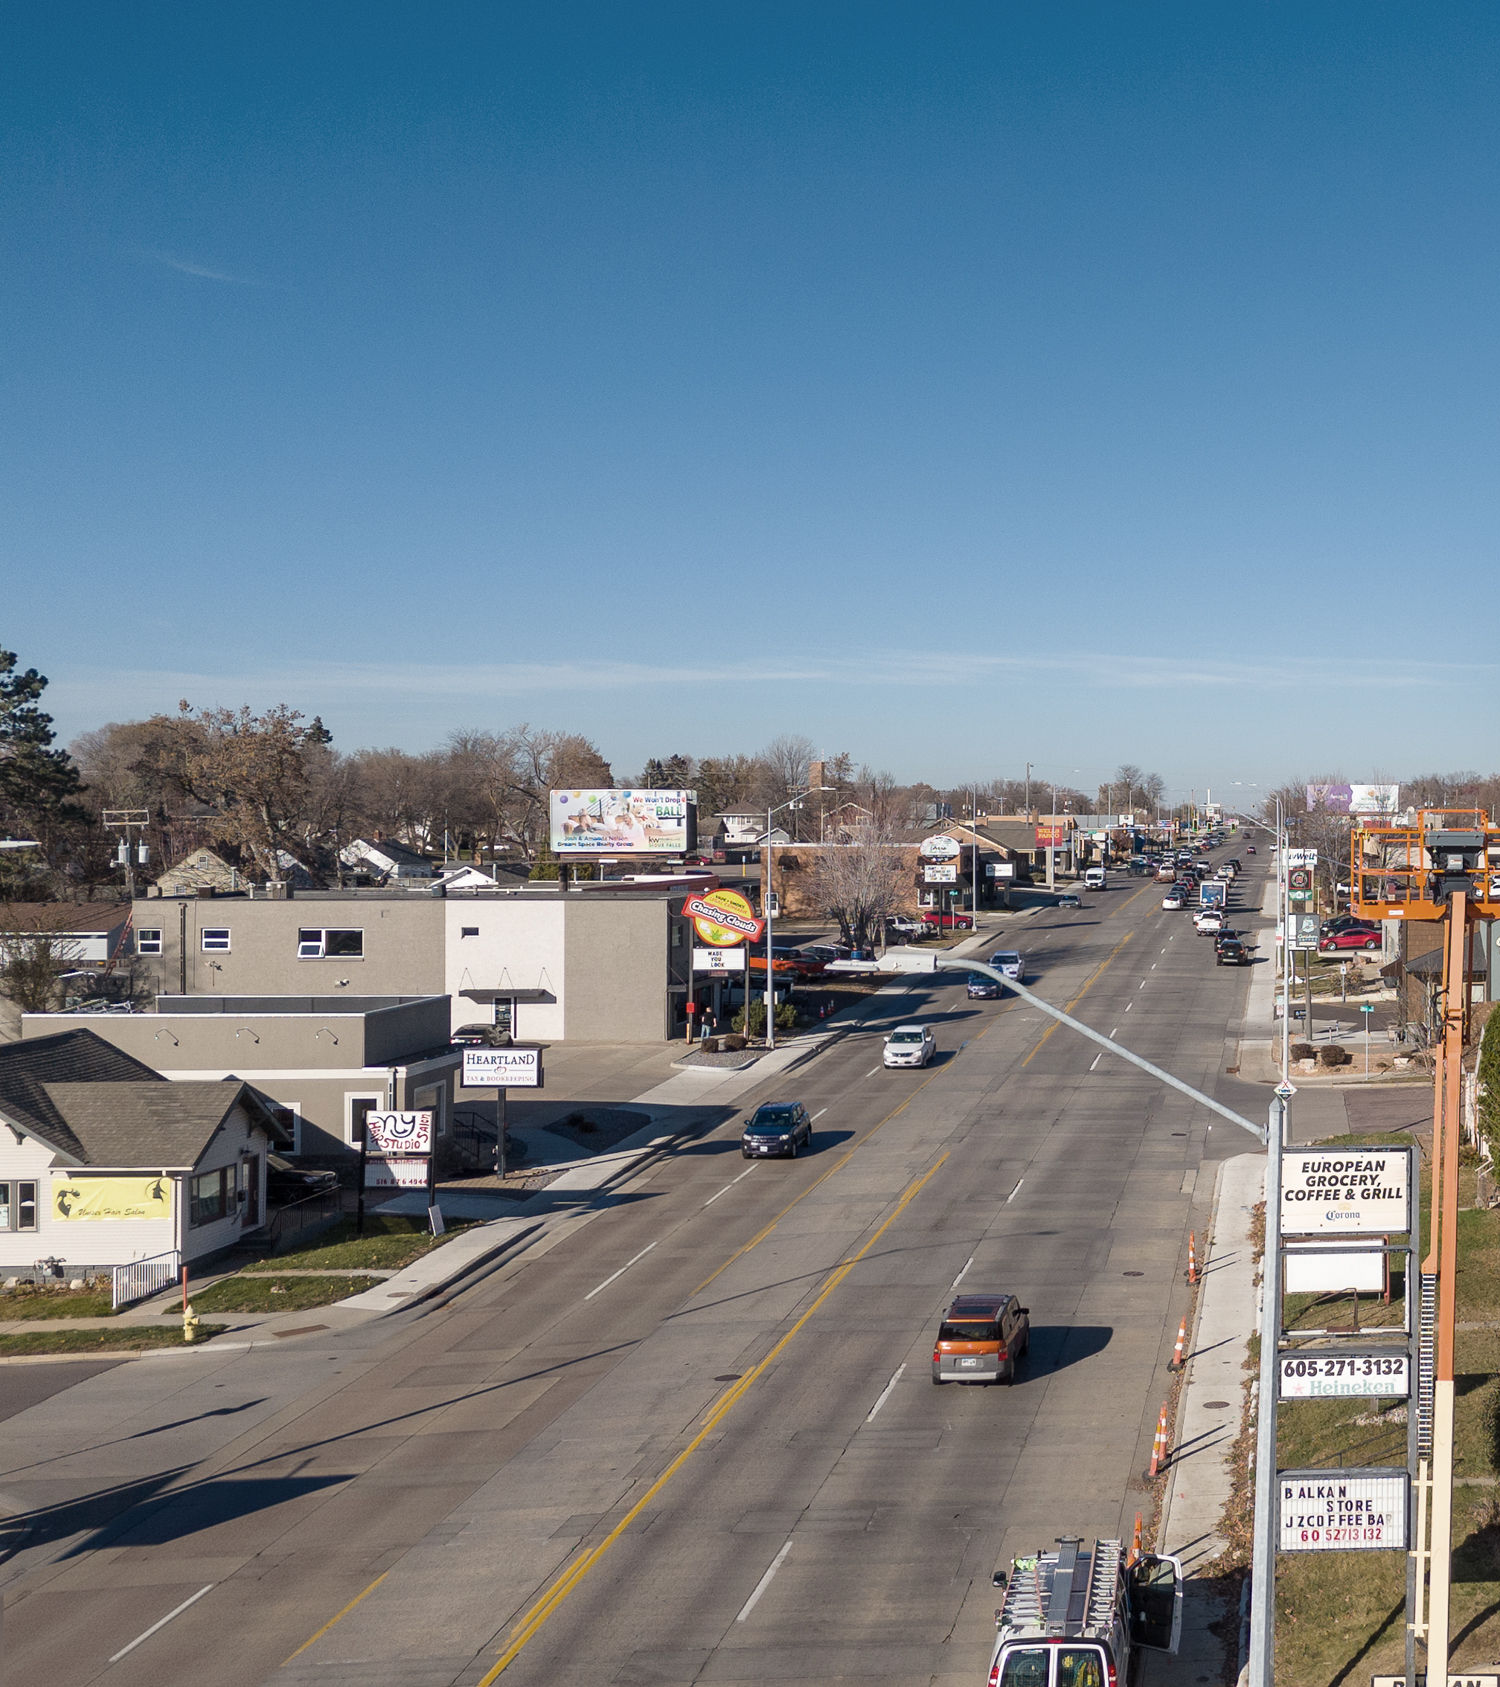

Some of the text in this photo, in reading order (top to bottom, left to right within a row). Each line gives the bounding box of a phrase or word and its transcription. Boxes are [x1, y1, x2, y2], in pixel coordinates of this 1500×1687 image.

[656, 806, 682, 816] BALL
[691, 901, 726, 923] Chasing
[726, 914, 757, 932] Clouds
[466, 1054, 535, 1064] HEARTLAND
[1302, 1160, 1386, 1173] EUROPEAN
[1306, 1174, 1381, 1187] GROCERY,
[1285, 1188, 1403, 1201] COFFEE & GRILL
[104, 1208, 121, 1216] Hair
[124, 1208, 145, 1216] Salon
[1326, 1210, 1360, 1221] Corona
[1284, 1359, 1404, 1377] 605-271-3132
[1309, 1380, 1395, 1395] Heineken
[1327, 1500, 1372, 1512] STORE
